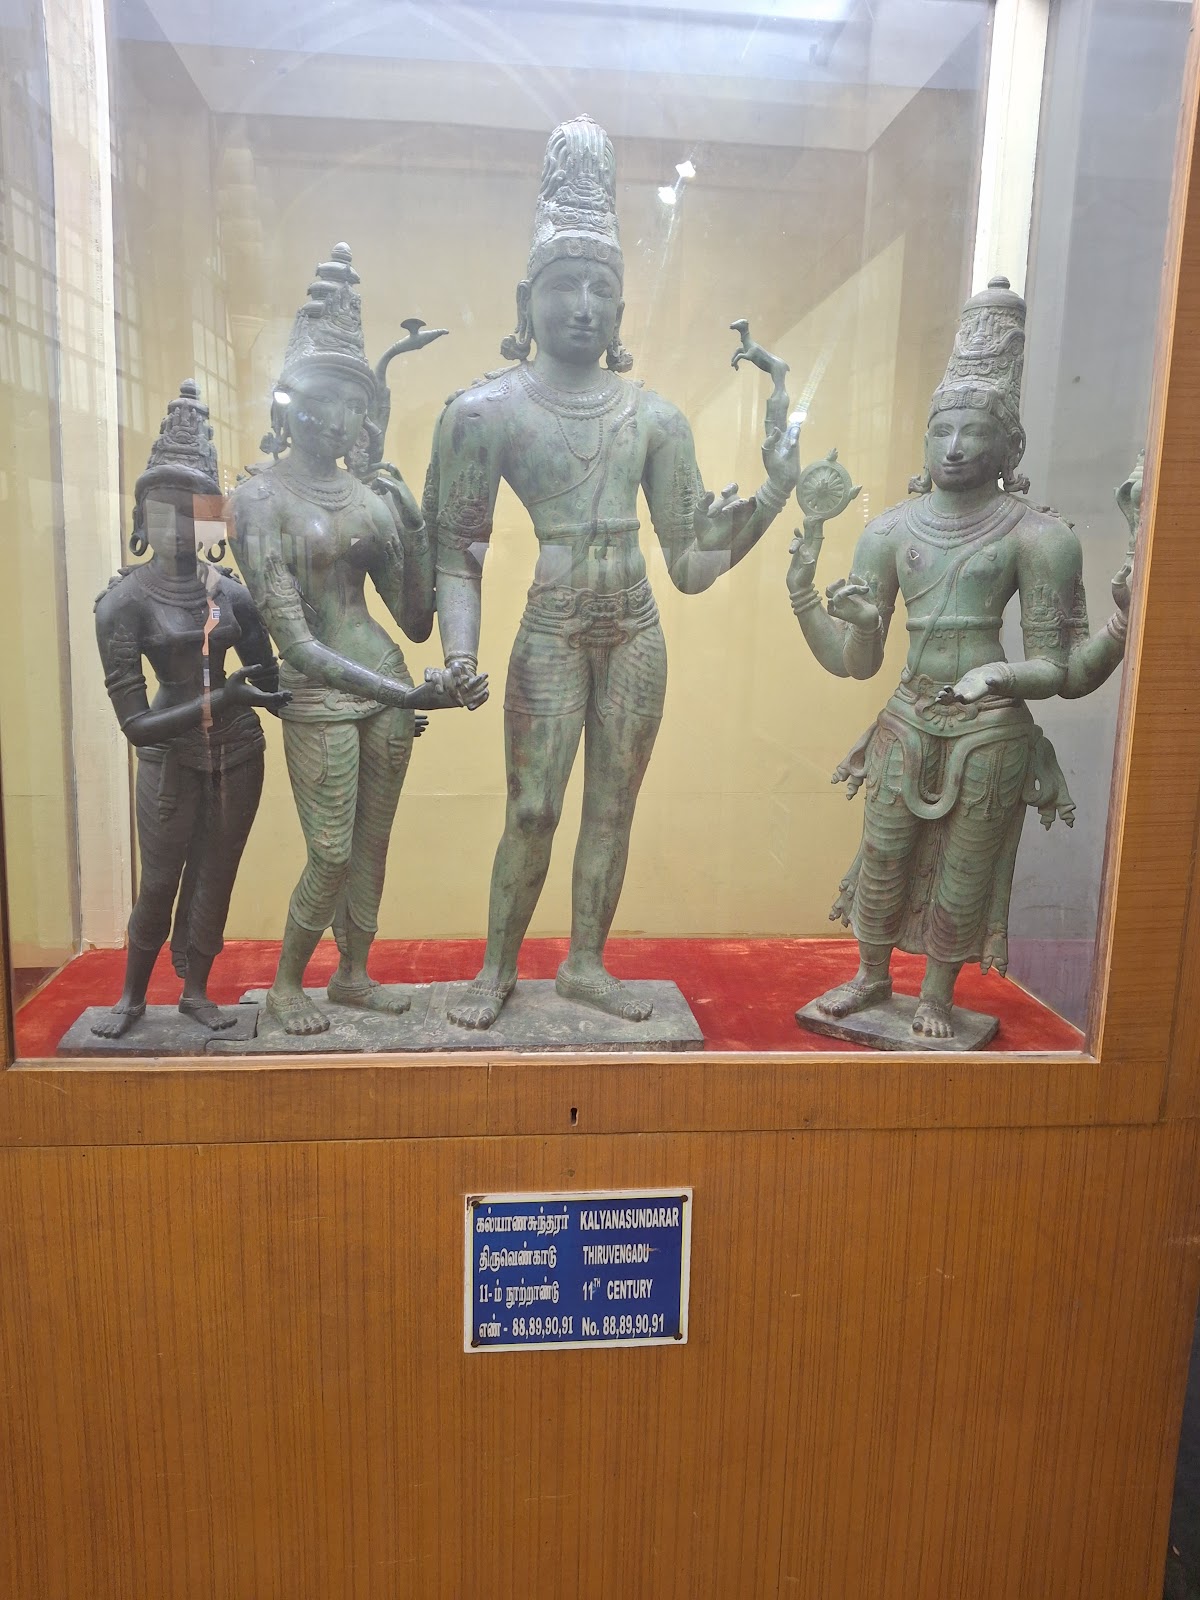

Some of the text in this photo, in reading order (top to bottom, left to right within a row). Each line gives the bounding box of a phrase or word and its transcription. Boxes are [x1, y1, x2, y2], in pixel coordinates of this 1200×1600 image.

[580, 1207, 679, 1231] KALYANASUNDARAR
[478, 1241, 557, 1273] திருவெண்காடு
[582, 1243, 650, 1265] THIRUVENGADU
[607, 1278, 653, 1300] CENTURY
[512, 1315, 573, 1340] 88,89,90,91
[582, 1313, 664, 1339] No. 88,89,90,91
